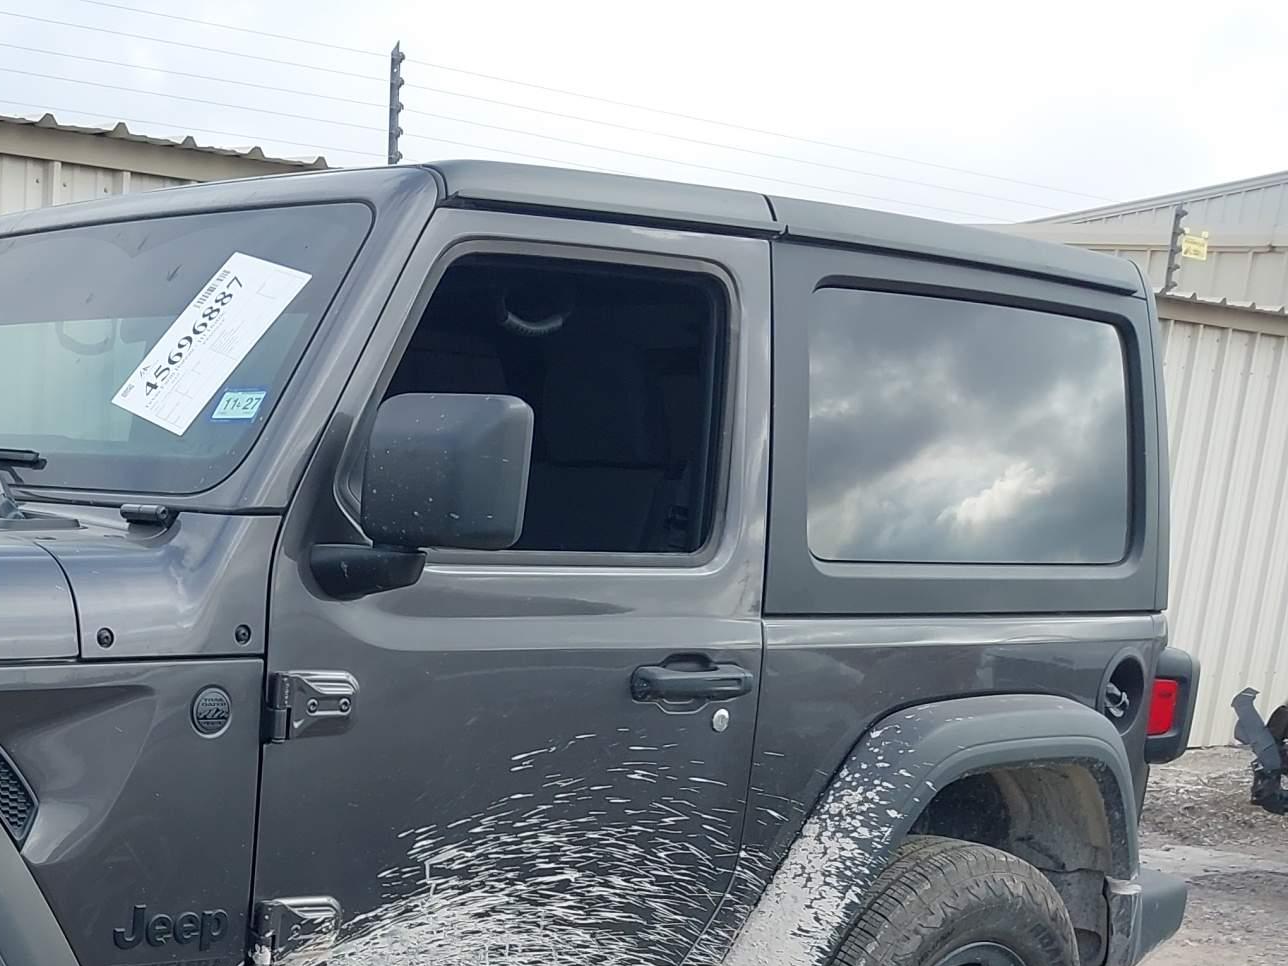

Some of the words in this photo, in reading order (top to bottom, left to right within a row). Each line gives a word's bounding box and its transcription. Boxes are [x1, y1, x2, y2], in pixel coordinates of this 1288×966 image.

[144, 275, 244, 397] 45696887
[223, 397, 239, 410] 11
[242, 397, 262, 410] 27
[112, 903, 229, 952] Jeep
